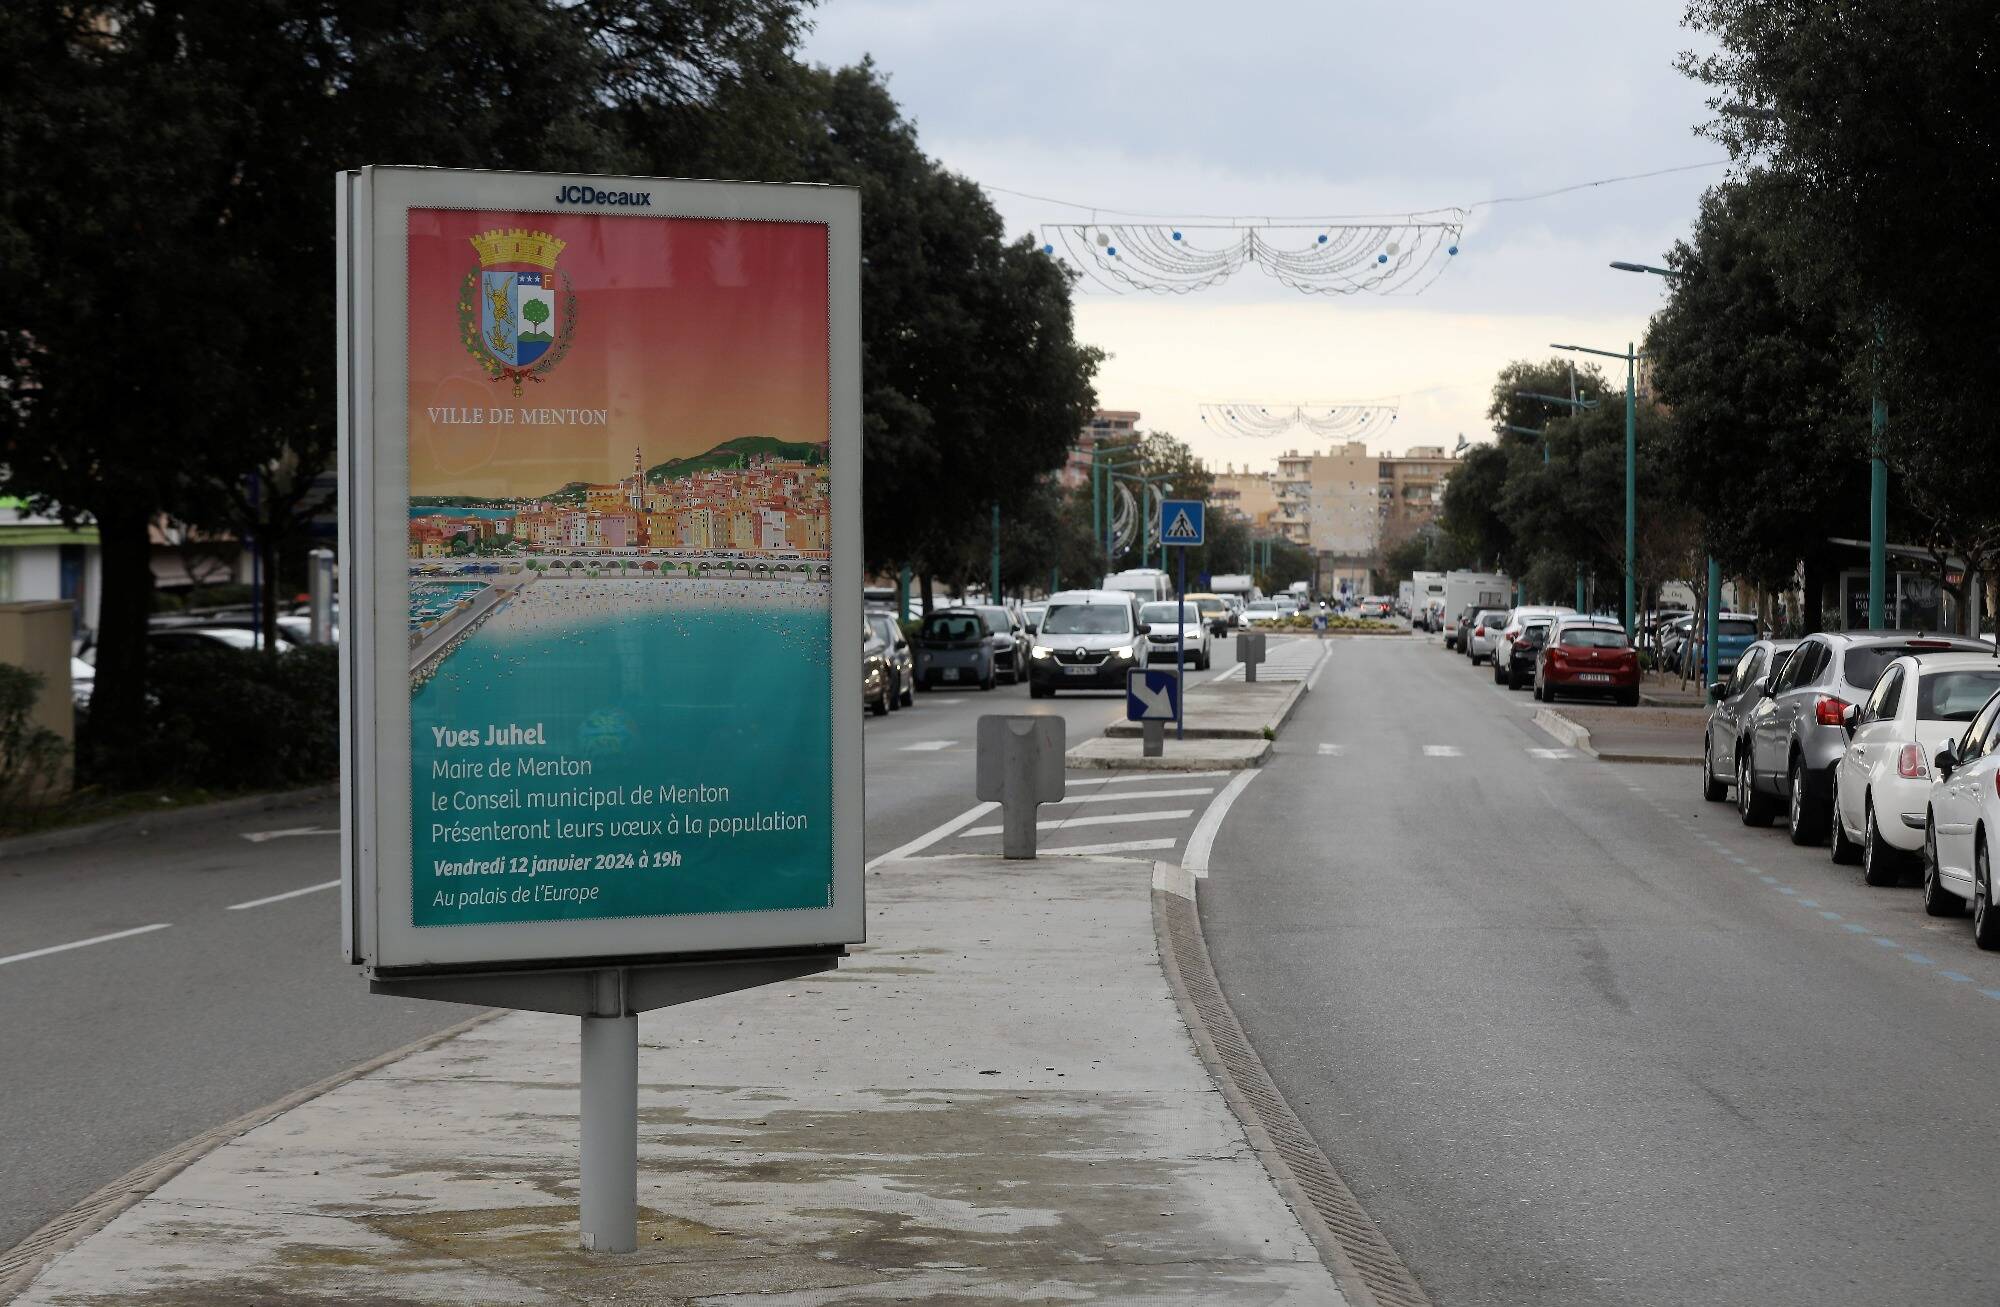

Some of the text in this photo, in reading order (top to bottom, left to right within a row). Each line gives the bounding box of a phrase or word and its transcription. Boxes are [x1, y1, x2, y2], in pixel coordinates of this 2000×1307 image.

[555, 185, 651, 206] JCDecaux
[428, 407, 608, 425] VILLE DE MENTON
[431, 722, 547, 748] Yves Juhel
[432, 755, 592, 780] Maire de Menton
[431, 783, 730, 812] le Conseil municipal de Menton
[432, 811, 808, 843] Présenteront leurs vœux à la population
[433, 849, 682, 877] Vendredi 12 janvier 2024 à 19h
[432, 884, 600, 910] Au palais de l’Europe
